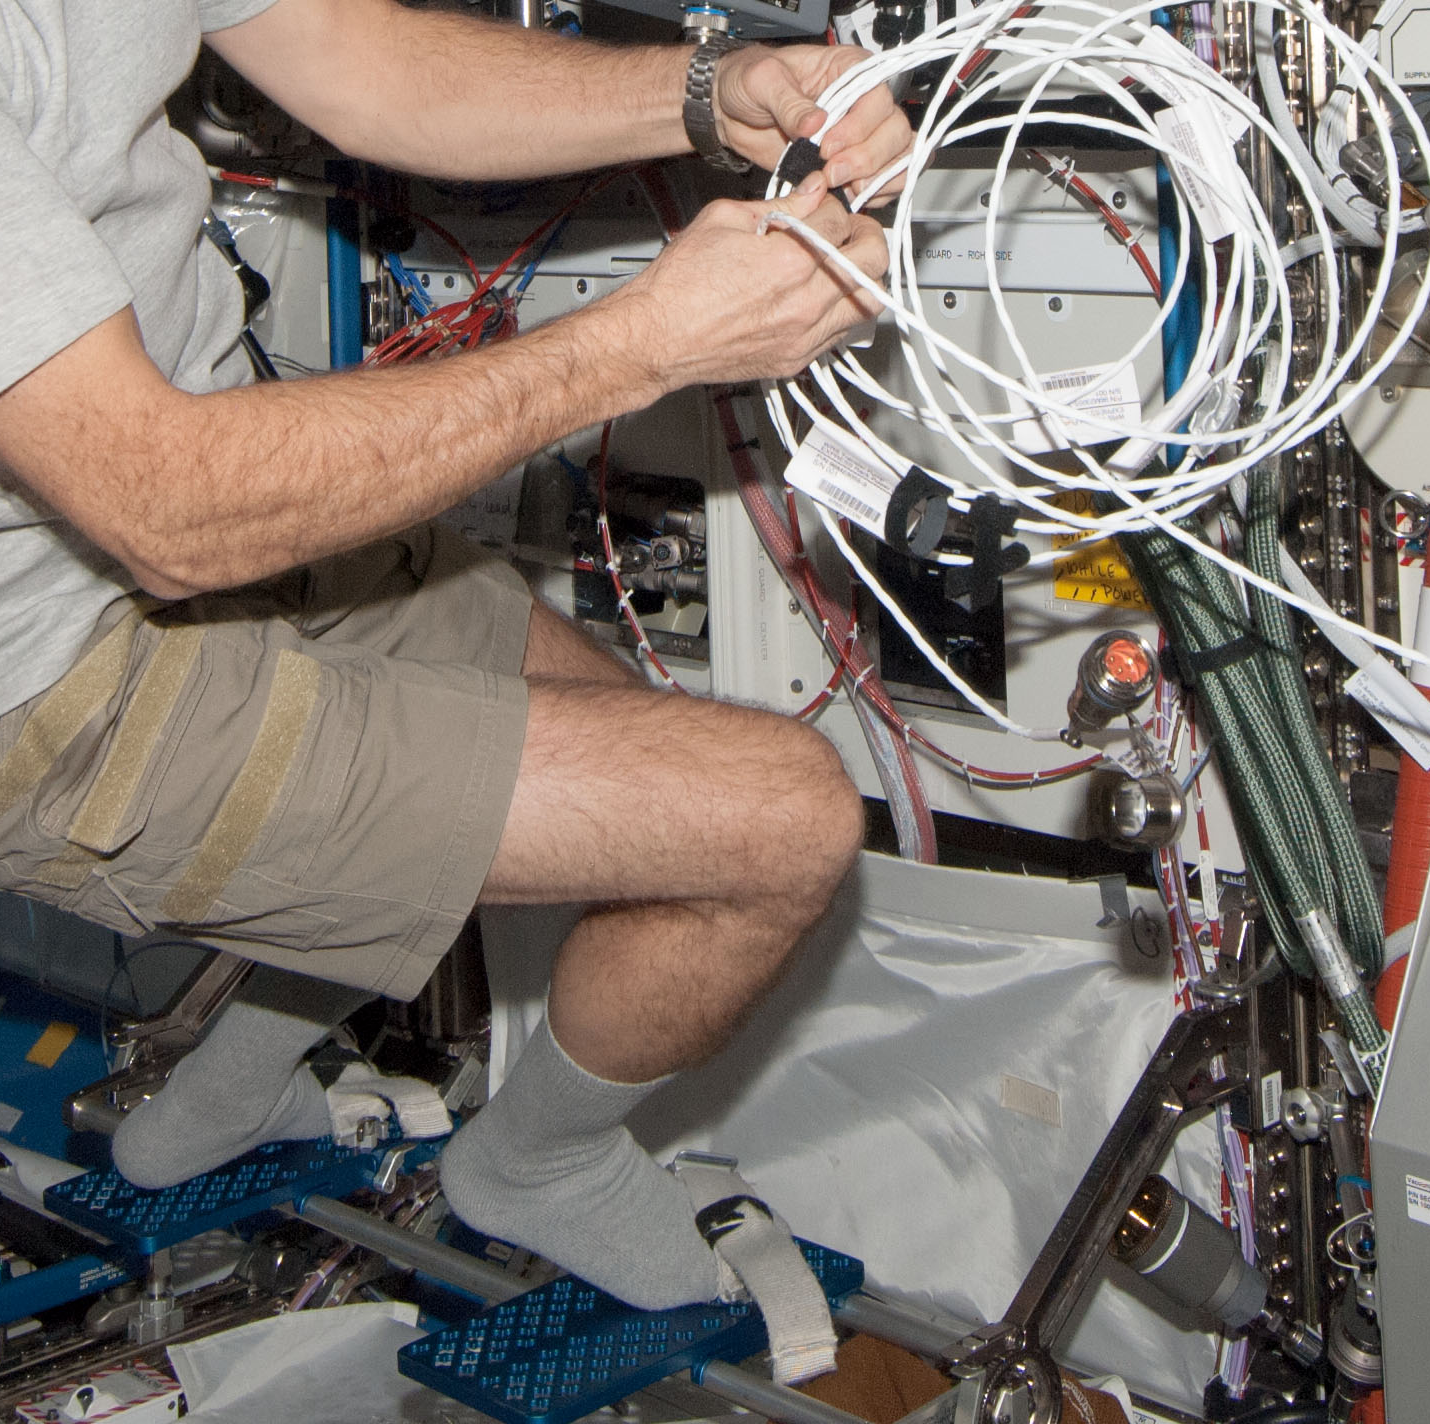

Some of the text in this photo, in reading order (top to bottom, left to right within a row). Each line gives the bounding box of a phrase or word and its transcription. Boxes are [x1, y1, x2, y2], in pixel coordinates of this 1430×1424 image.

[926, 249, 1013, 261] GUARD SIDE
[1065, 557, 1116, 578] WHILE
